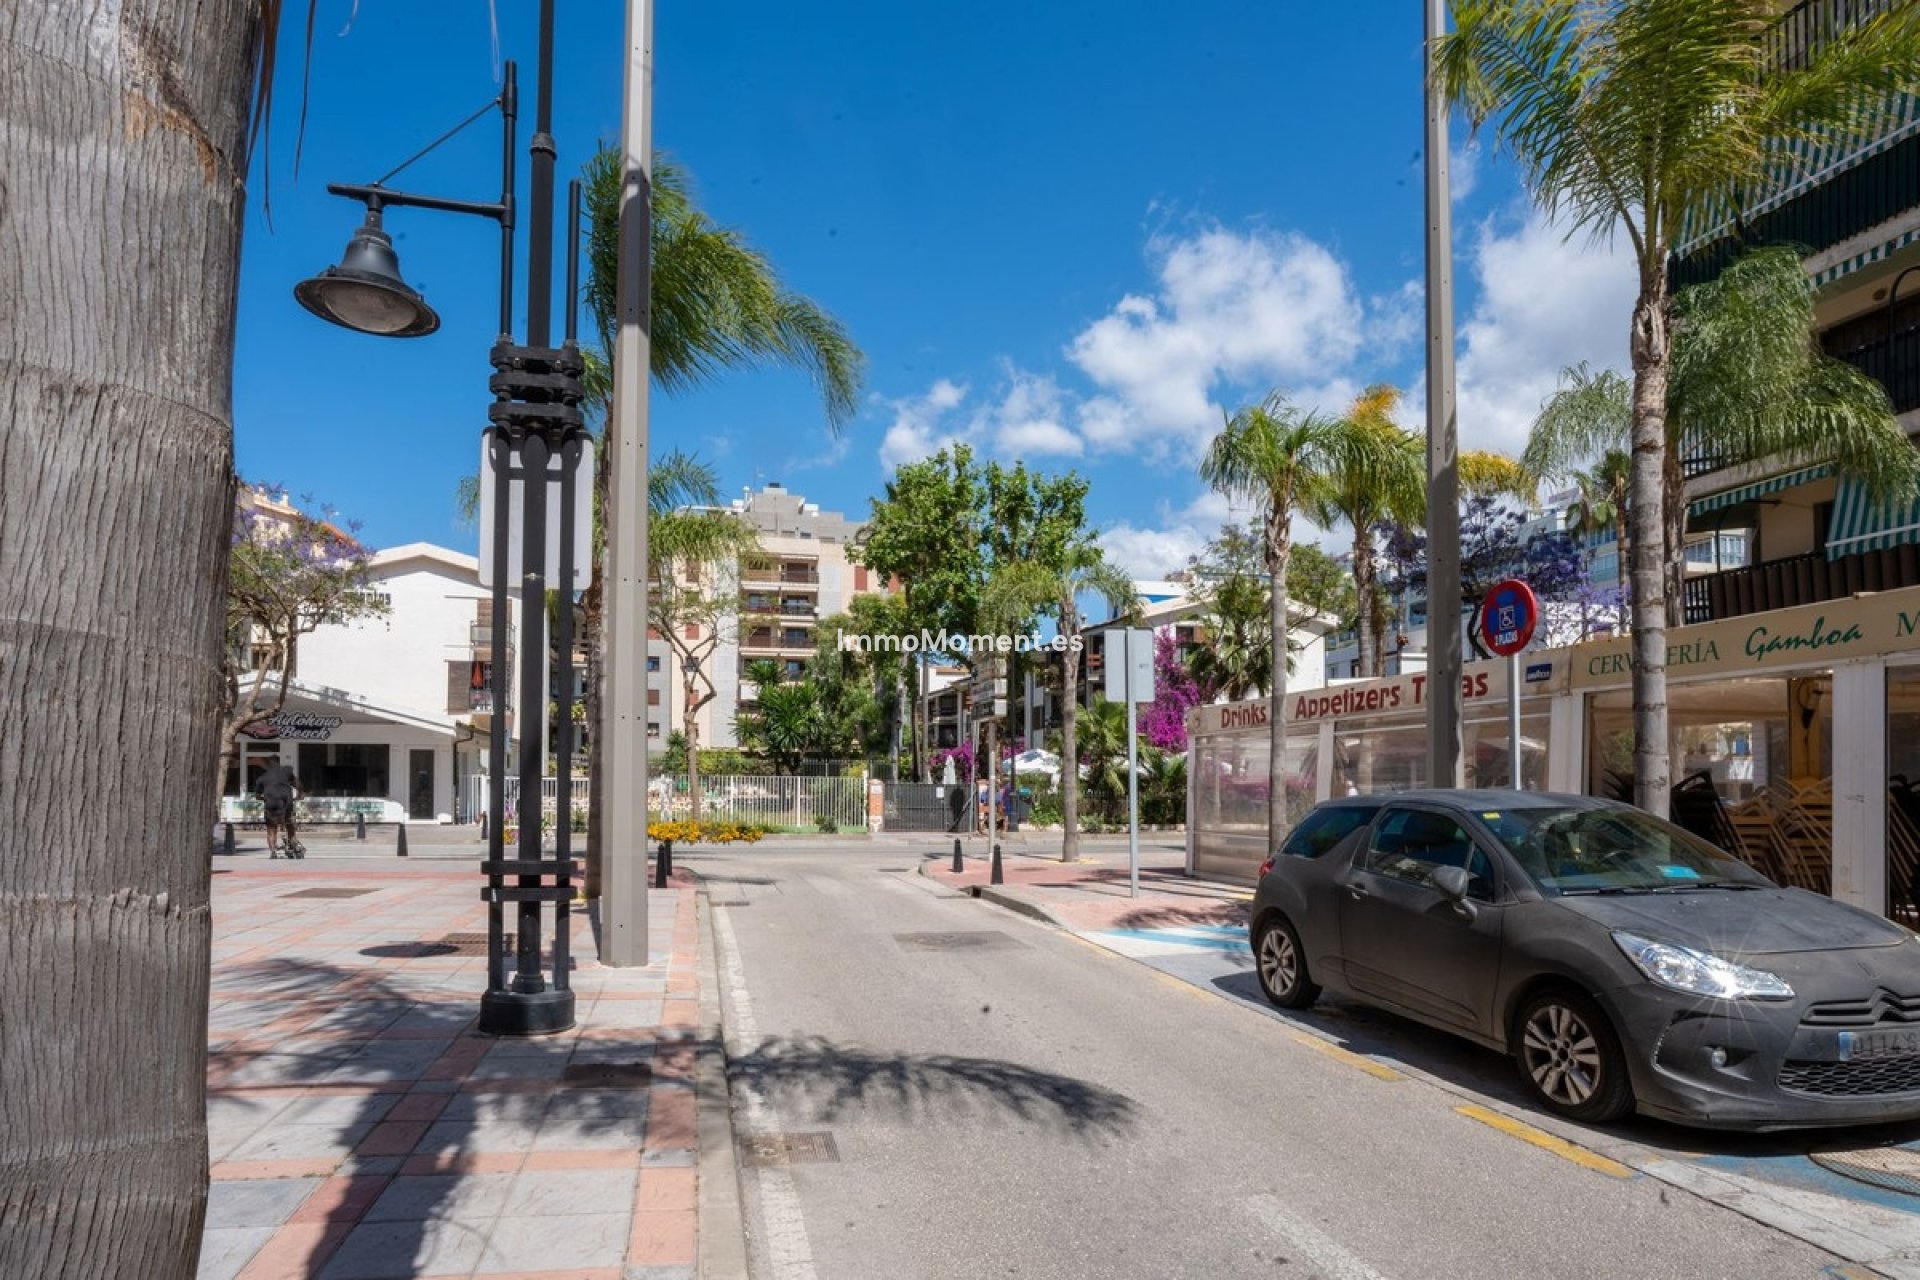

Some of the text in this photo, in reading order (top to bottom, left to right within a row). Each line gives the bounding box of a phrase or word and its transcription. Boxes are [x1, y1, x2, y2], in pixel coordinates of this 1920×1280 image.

[1745, 616, 1863, 661] Gamboa
[1221, 672, 1489, 729] Drinks Appetizers Tas
[279, 725, 331, 741] Beach
